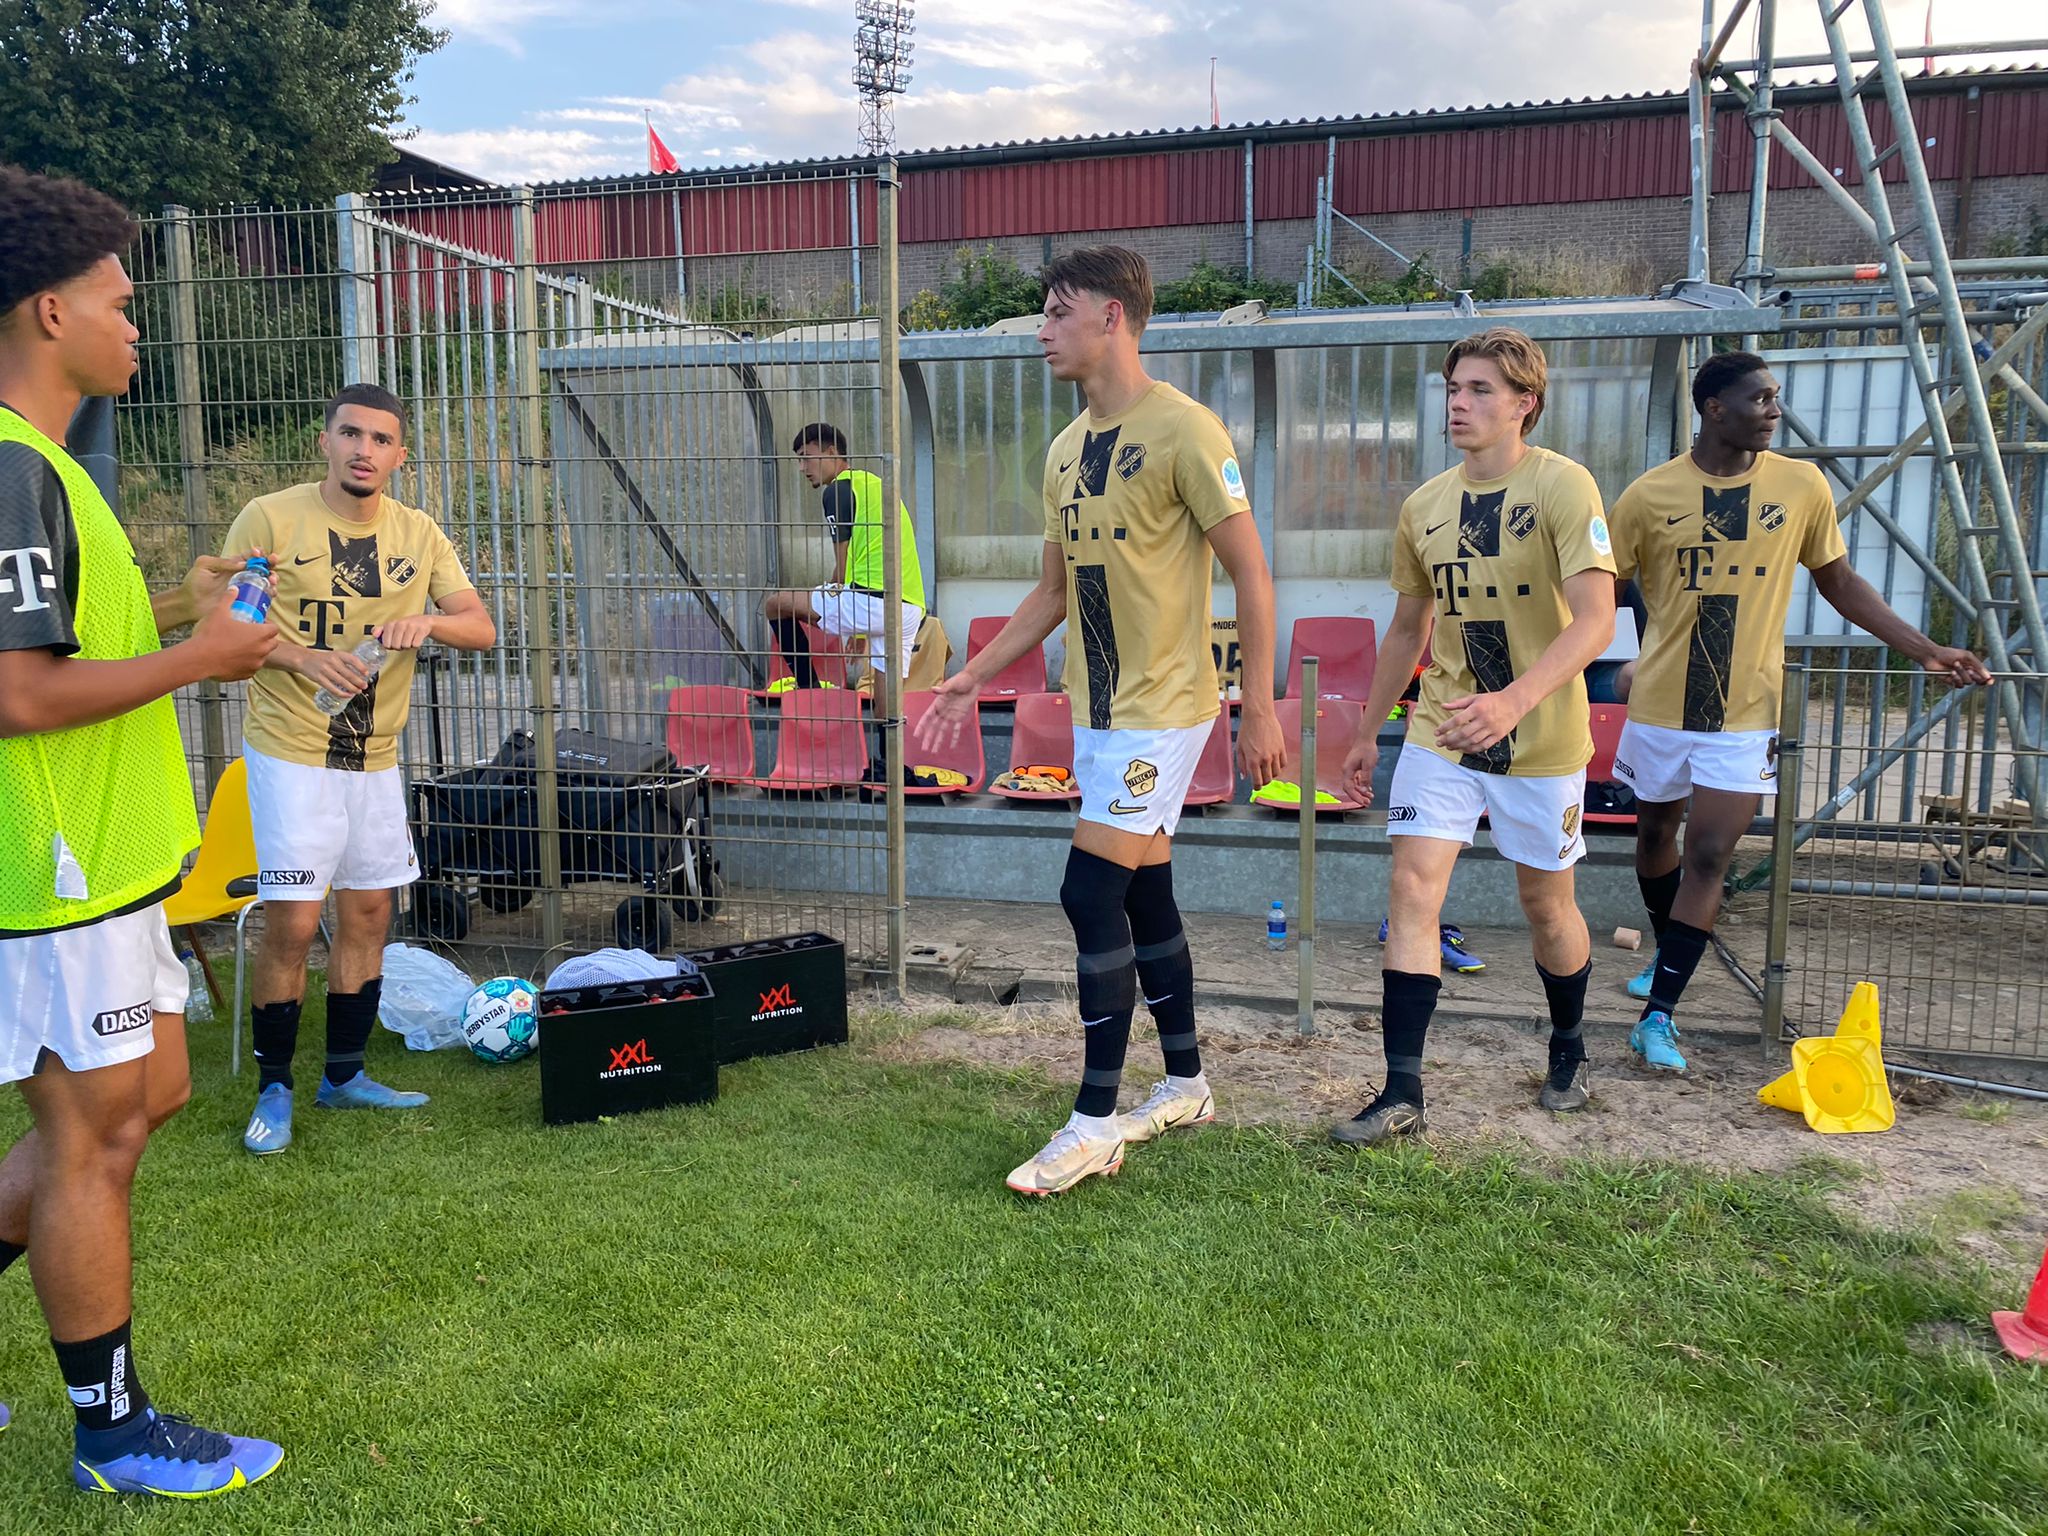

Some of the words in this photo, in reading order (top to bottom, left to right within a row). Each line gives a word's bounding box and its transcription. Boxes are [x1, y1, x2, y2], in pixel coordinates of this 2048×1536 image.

[299, 598, 345, 651] T
[262, 871, 303, 884] DASSY
[751, 1006, 803, 1022] NUTRITION
[758, 983, 797, 1014] XXL
[101, 1002, 151, 1034] DASSY
[465, 1005, 506, 1038] DERBYSTAR
[609, 1038, 654, 1071] XXL
[600, 1064, 662, 1079] NUTRITION
